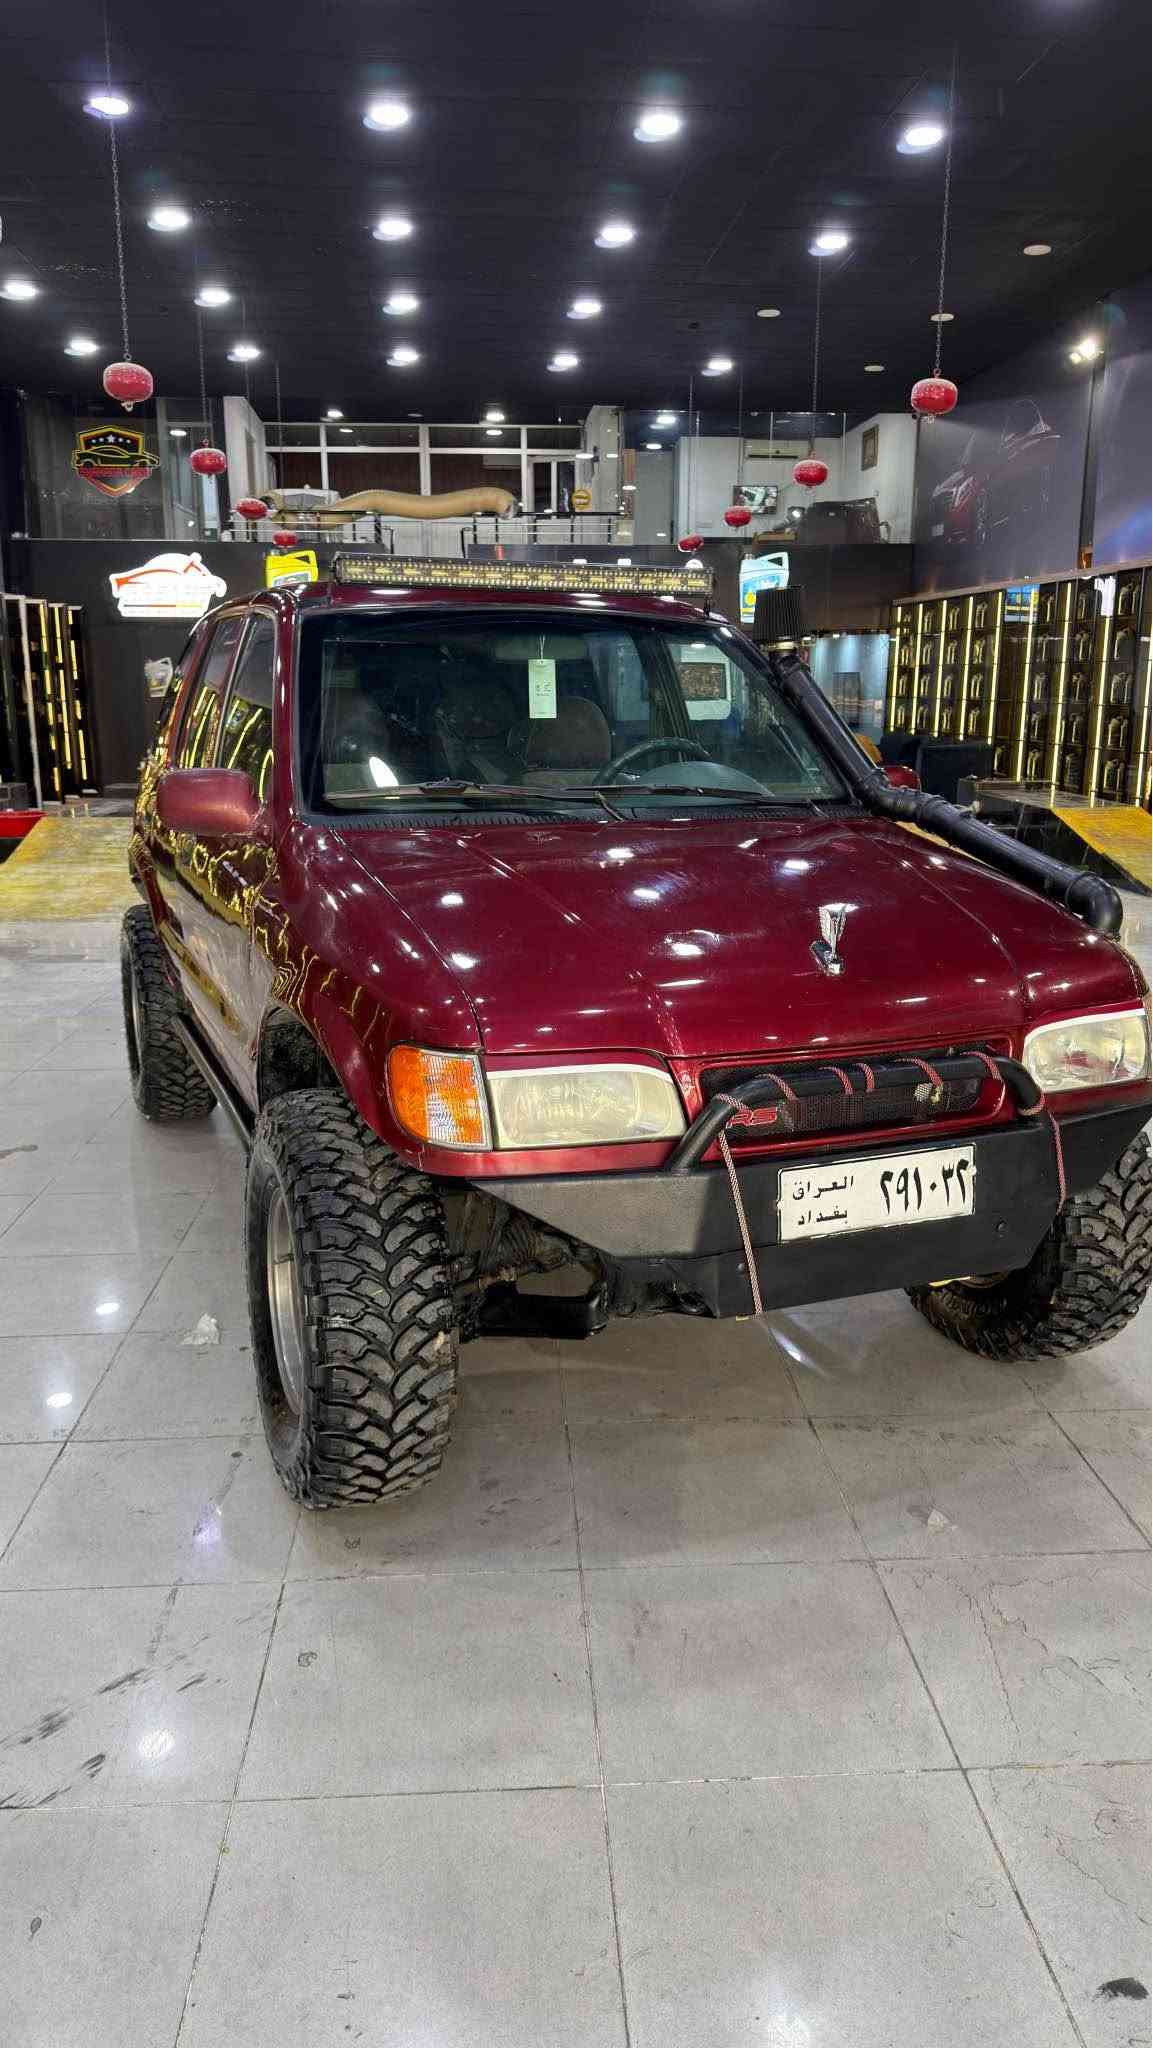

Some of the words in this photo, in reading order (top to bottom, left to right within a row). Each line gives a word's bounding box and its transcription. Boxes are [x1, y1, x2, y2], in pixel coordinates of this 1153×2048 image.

[792, 1175, 854, 1201] العراق
[879, 1158, 970, 1215] ٢٩١٠٣٢
[797, 1205, 848, 1226] بغداد
